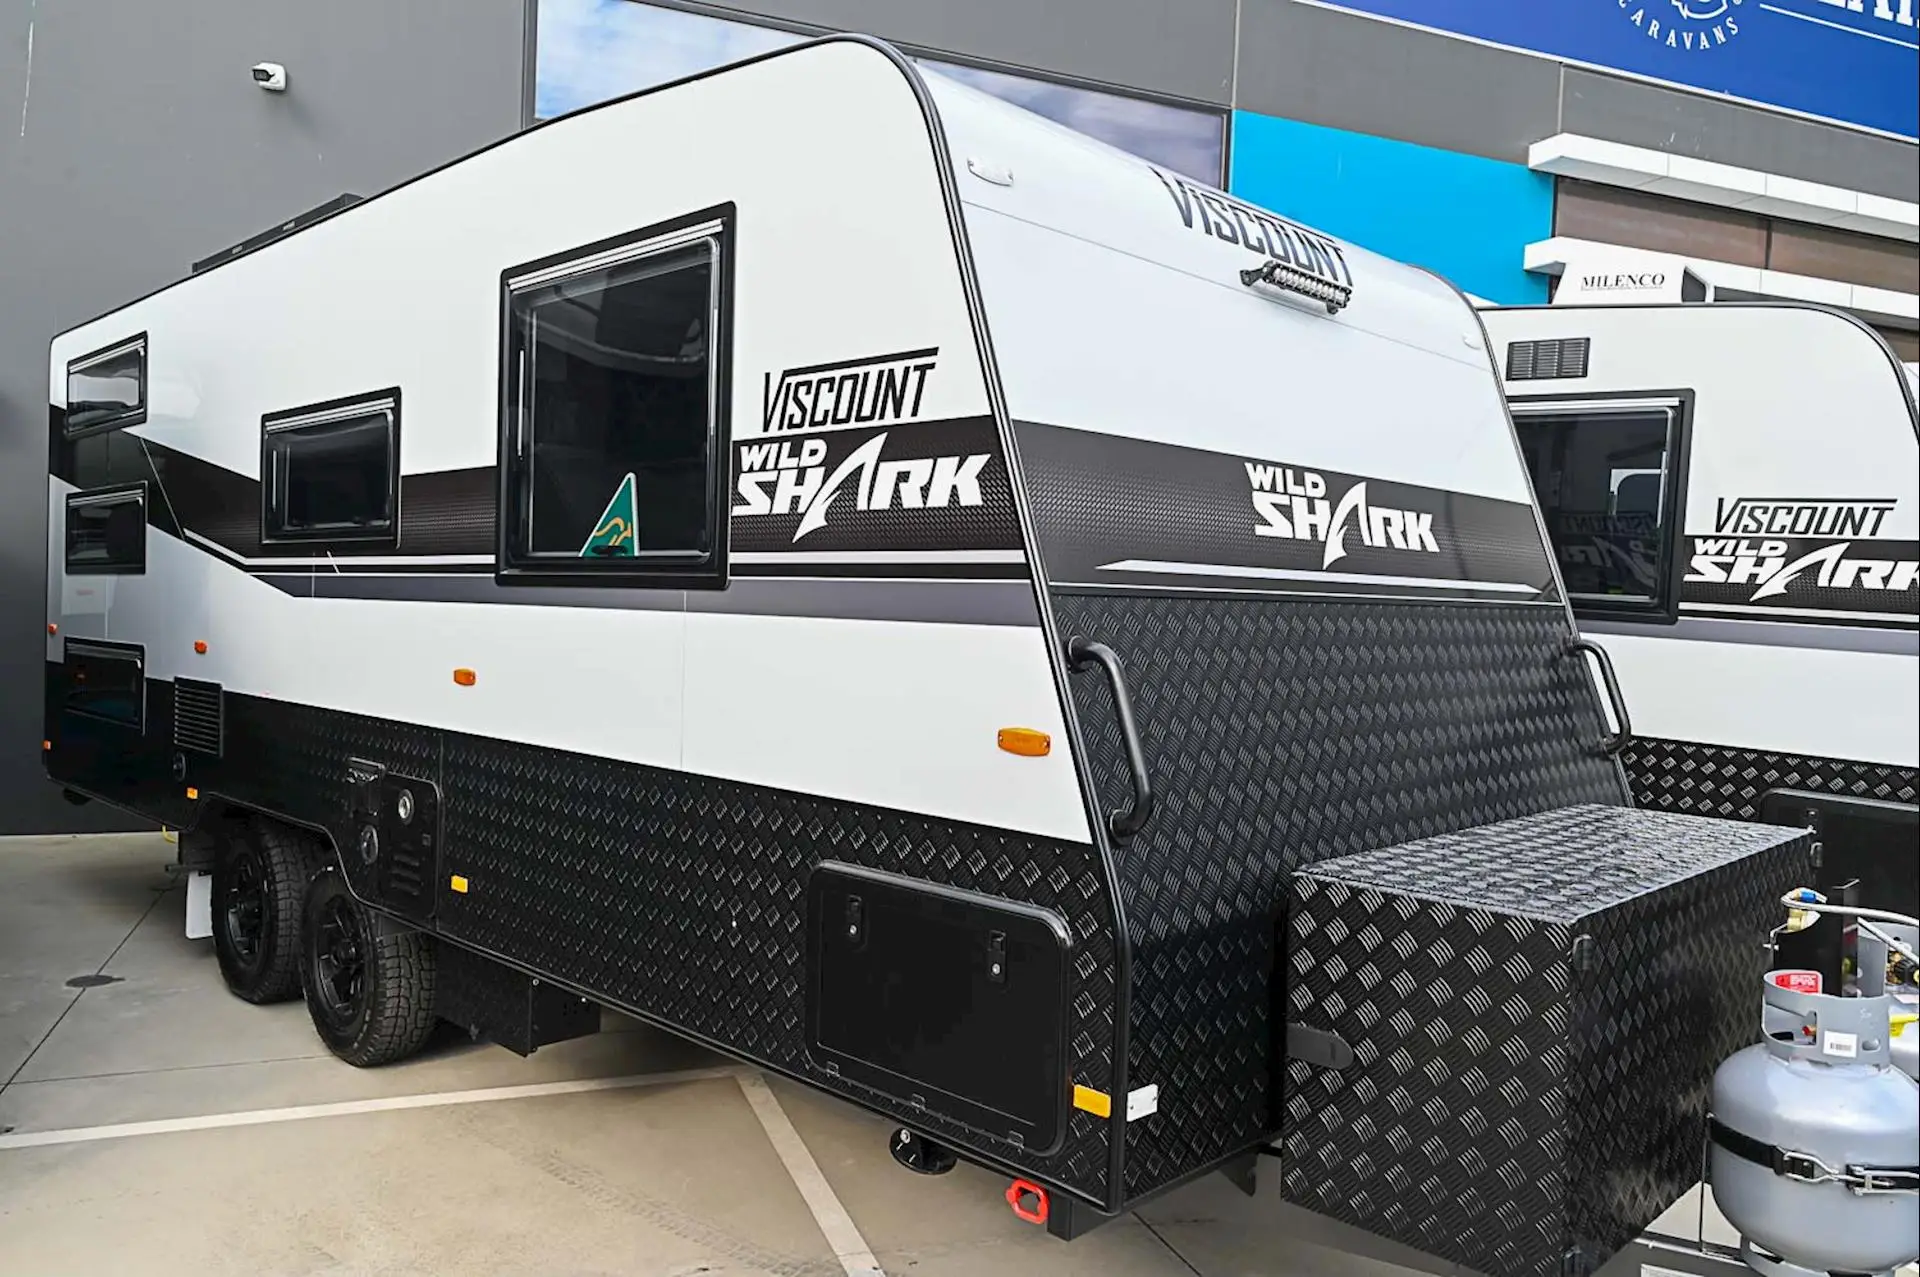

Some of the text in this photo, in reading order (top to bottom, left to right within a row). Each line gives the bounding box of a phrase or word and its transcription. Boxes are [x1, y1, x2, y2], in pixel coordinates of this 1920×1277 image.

[1148, 166, 1352, 287] VISCOUNT
[1581, 273, 1665, 287] MILENCO
[763, 346, 939, 432] VISCOUNT
[739, 439, 828, 471] WILD
[732, 432, 992, 543] SHARK
[1244, 462, 1327, 498] WILD
[1252, 481, 1440, 570] SHARK
[1715, 497, 1898, 536] VISCOUNT
[1694, 538, 1789, 557] WILD
